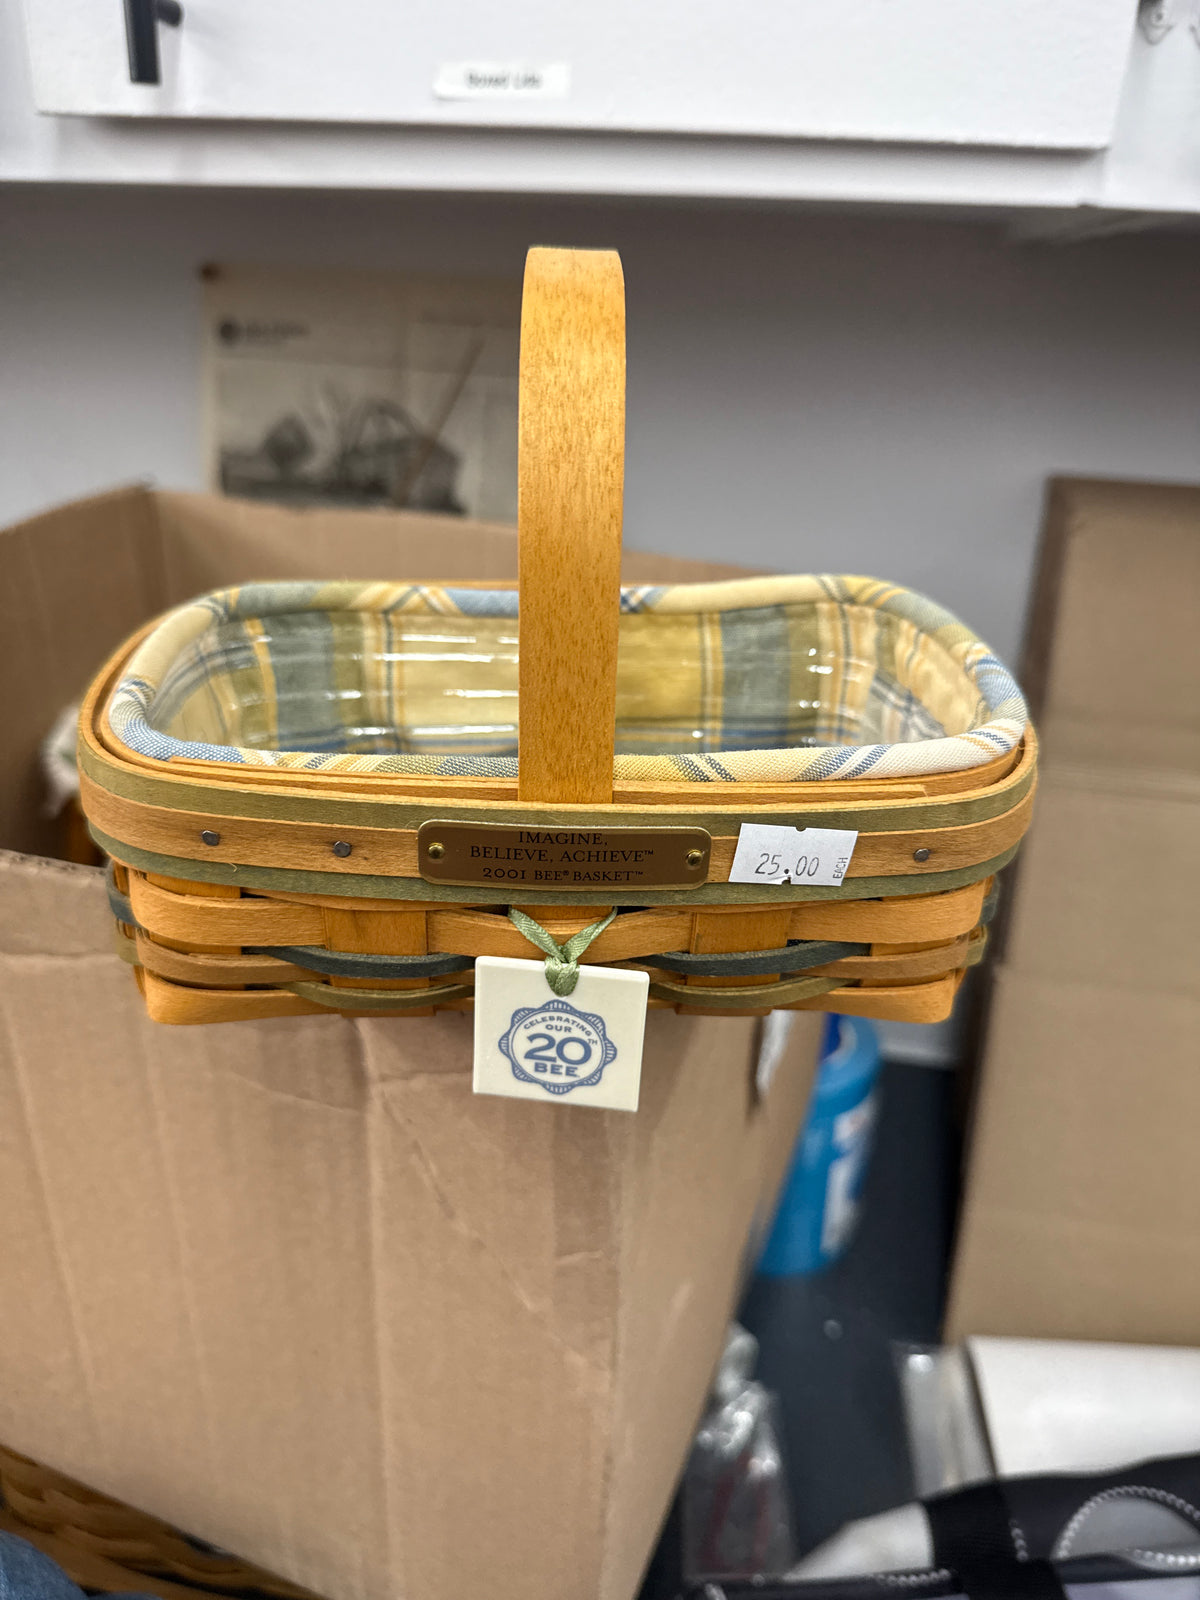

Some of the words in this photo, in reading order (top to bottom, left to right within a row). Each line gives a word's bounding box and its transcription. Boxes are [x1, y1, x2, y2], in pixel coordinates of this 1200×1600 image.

[519, 831, 608, 847] IMAGINE,
[470, 846, 554, 863] BELIEVE,
[483, 867, 526, 880] 2001
[755, 853, 820, 877] 25.00
[833, 857, 848, 879] EACH
[523, 1015, 593, 1037] CELEBRATING
[545, 1024, 572, 1033] OUR
[534, 1061, 579, 1078] BEE
